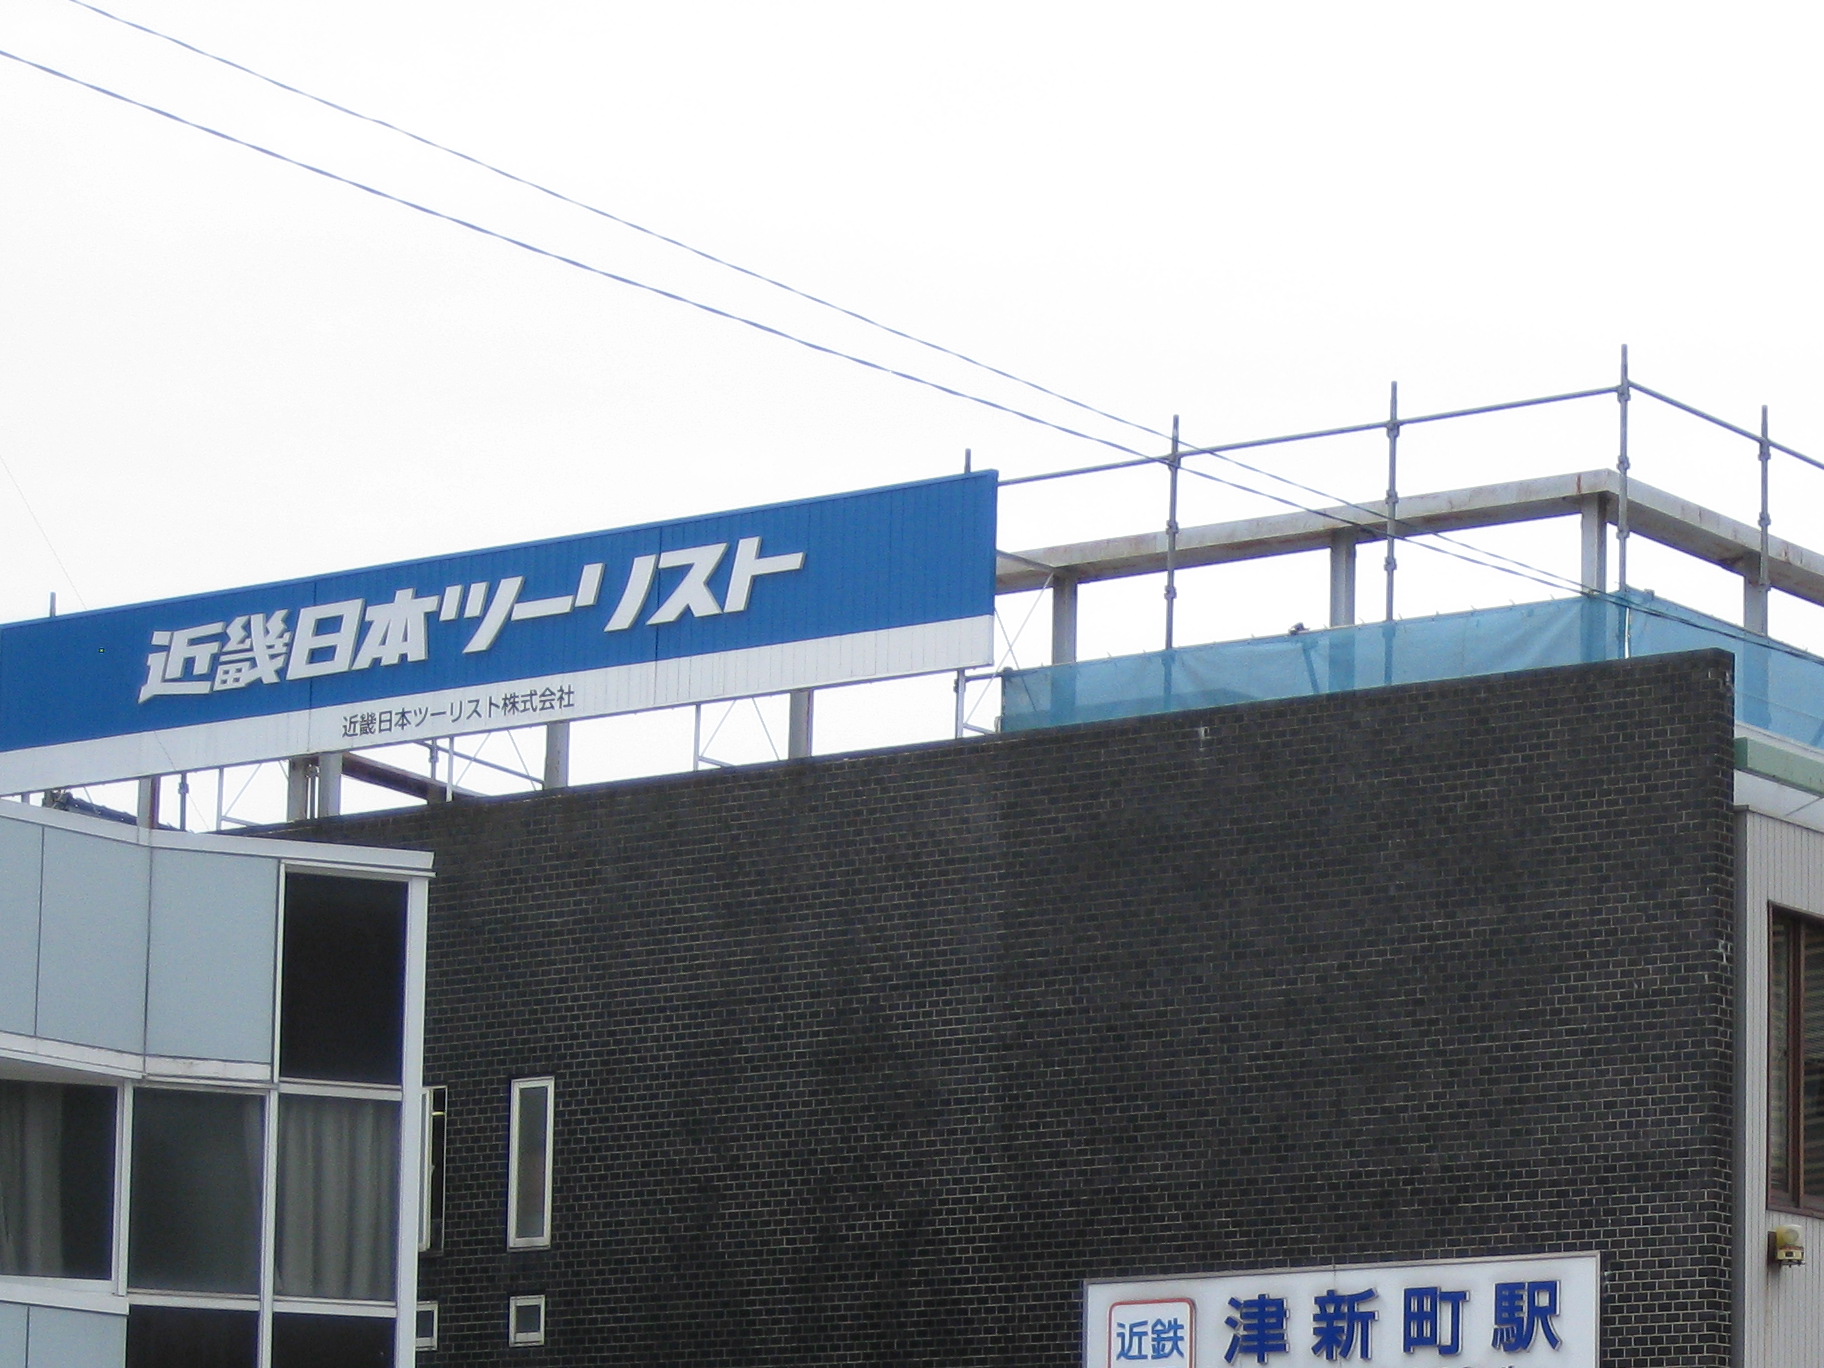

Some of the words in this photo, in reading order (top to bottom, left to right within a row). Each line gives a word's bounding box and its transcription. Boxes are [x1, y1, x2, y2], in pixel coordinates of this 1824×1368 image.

[138, 536, 806, 704] 近畿日本ツーリスト
[341, 684, 575, 738] 近畿日本ツーリスト株式会社
[1115, 1317, 1186, 1361] 近鉄
[1223, 1280, 1563, 1364] 津新町駅
